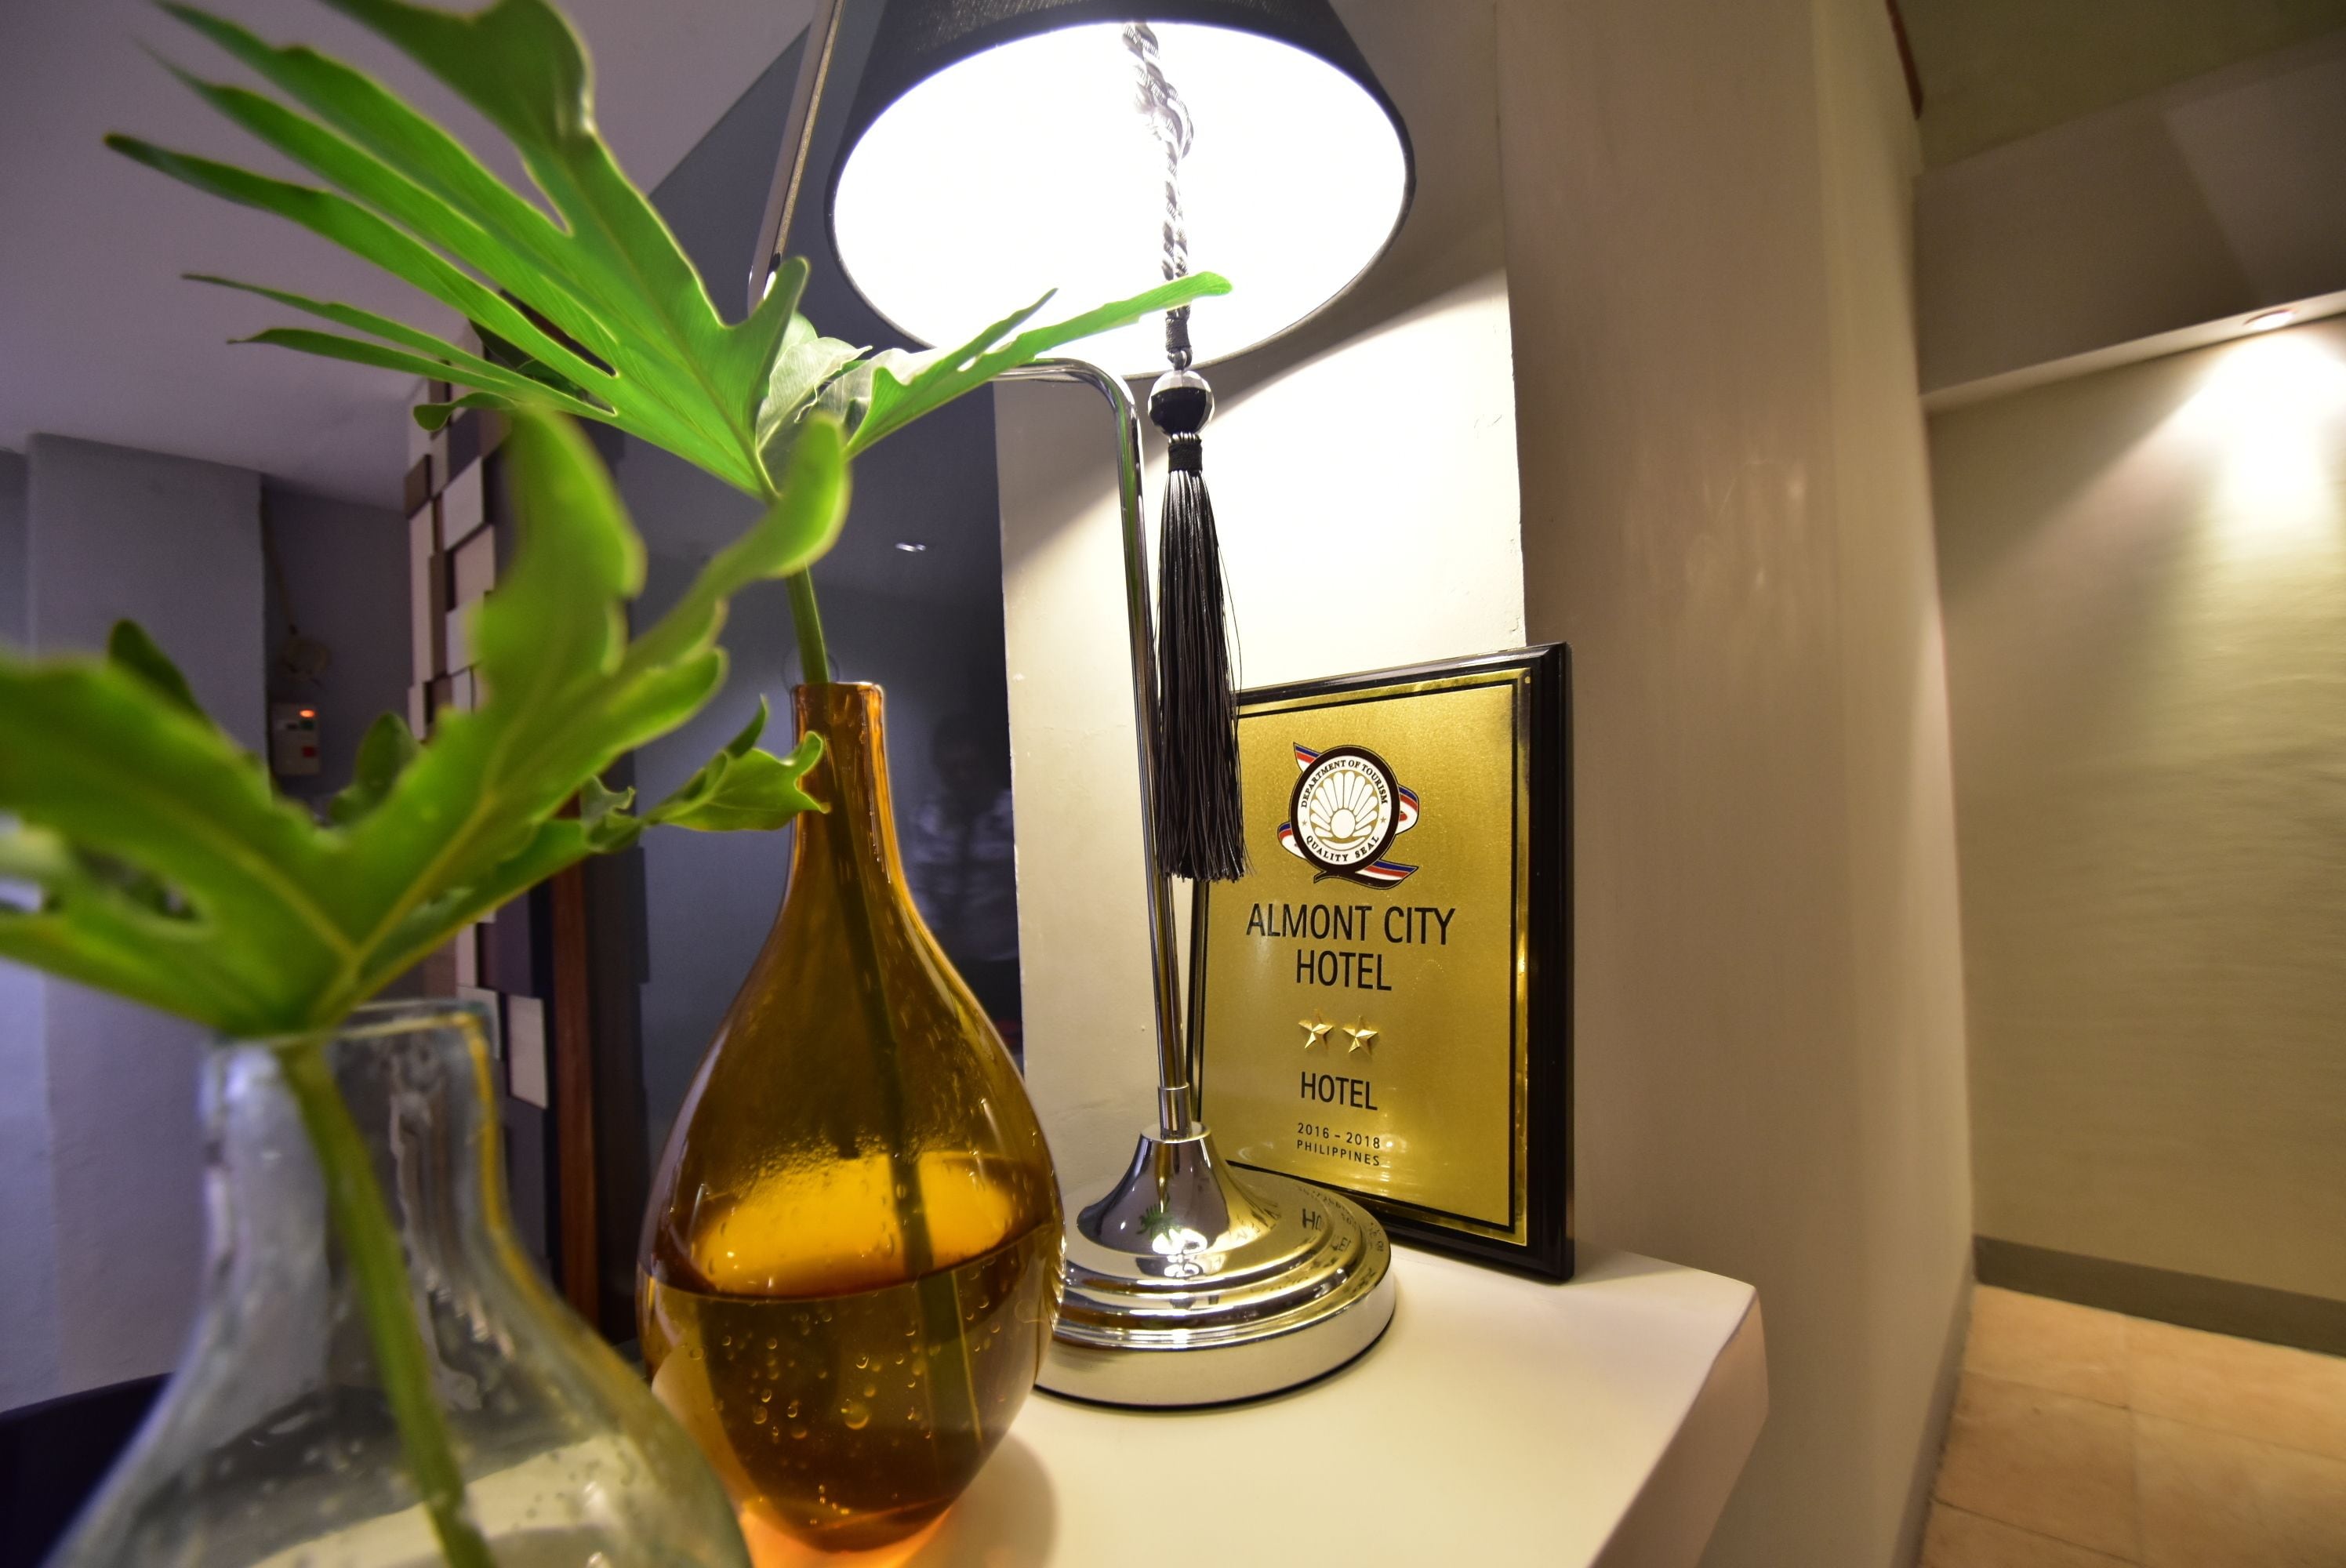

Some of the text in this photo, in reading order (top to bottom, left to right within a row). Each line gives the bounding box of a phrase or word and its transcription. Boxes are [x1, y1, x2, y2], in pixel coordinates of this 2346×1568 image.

[1301, 759, 1389, 808] DEPARTMENT OF TOURISM
[1306, 835, 1380, 862] QUALITY SEAL
[1246, 903, 1456, 946] ALMONT CITY
[1296, 949, 1393, 991] HOTEL
[1300, 1071, 1378, 1111] HOTEL
[1297, 1140, 1380, 1167] PHILIPPINES
